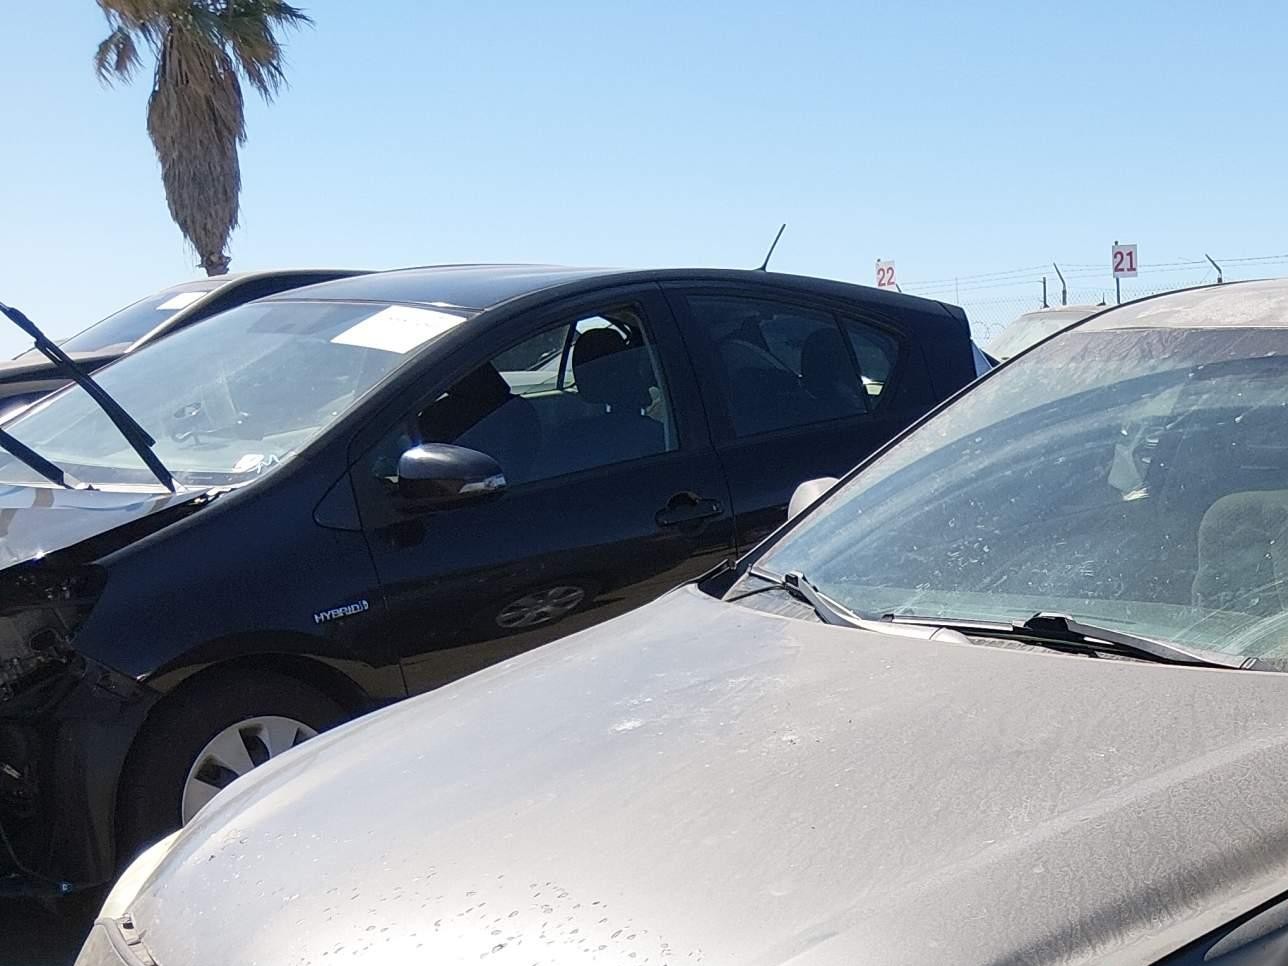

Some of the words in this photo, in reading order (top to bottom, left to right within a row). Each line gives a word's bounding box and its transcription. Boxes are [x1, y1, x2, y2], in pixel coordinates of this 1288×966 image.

[1113, 250, 1137, 272] 21
[877, 266, 895, 287] 22
[314, 601, 363, 624] HYBRID
